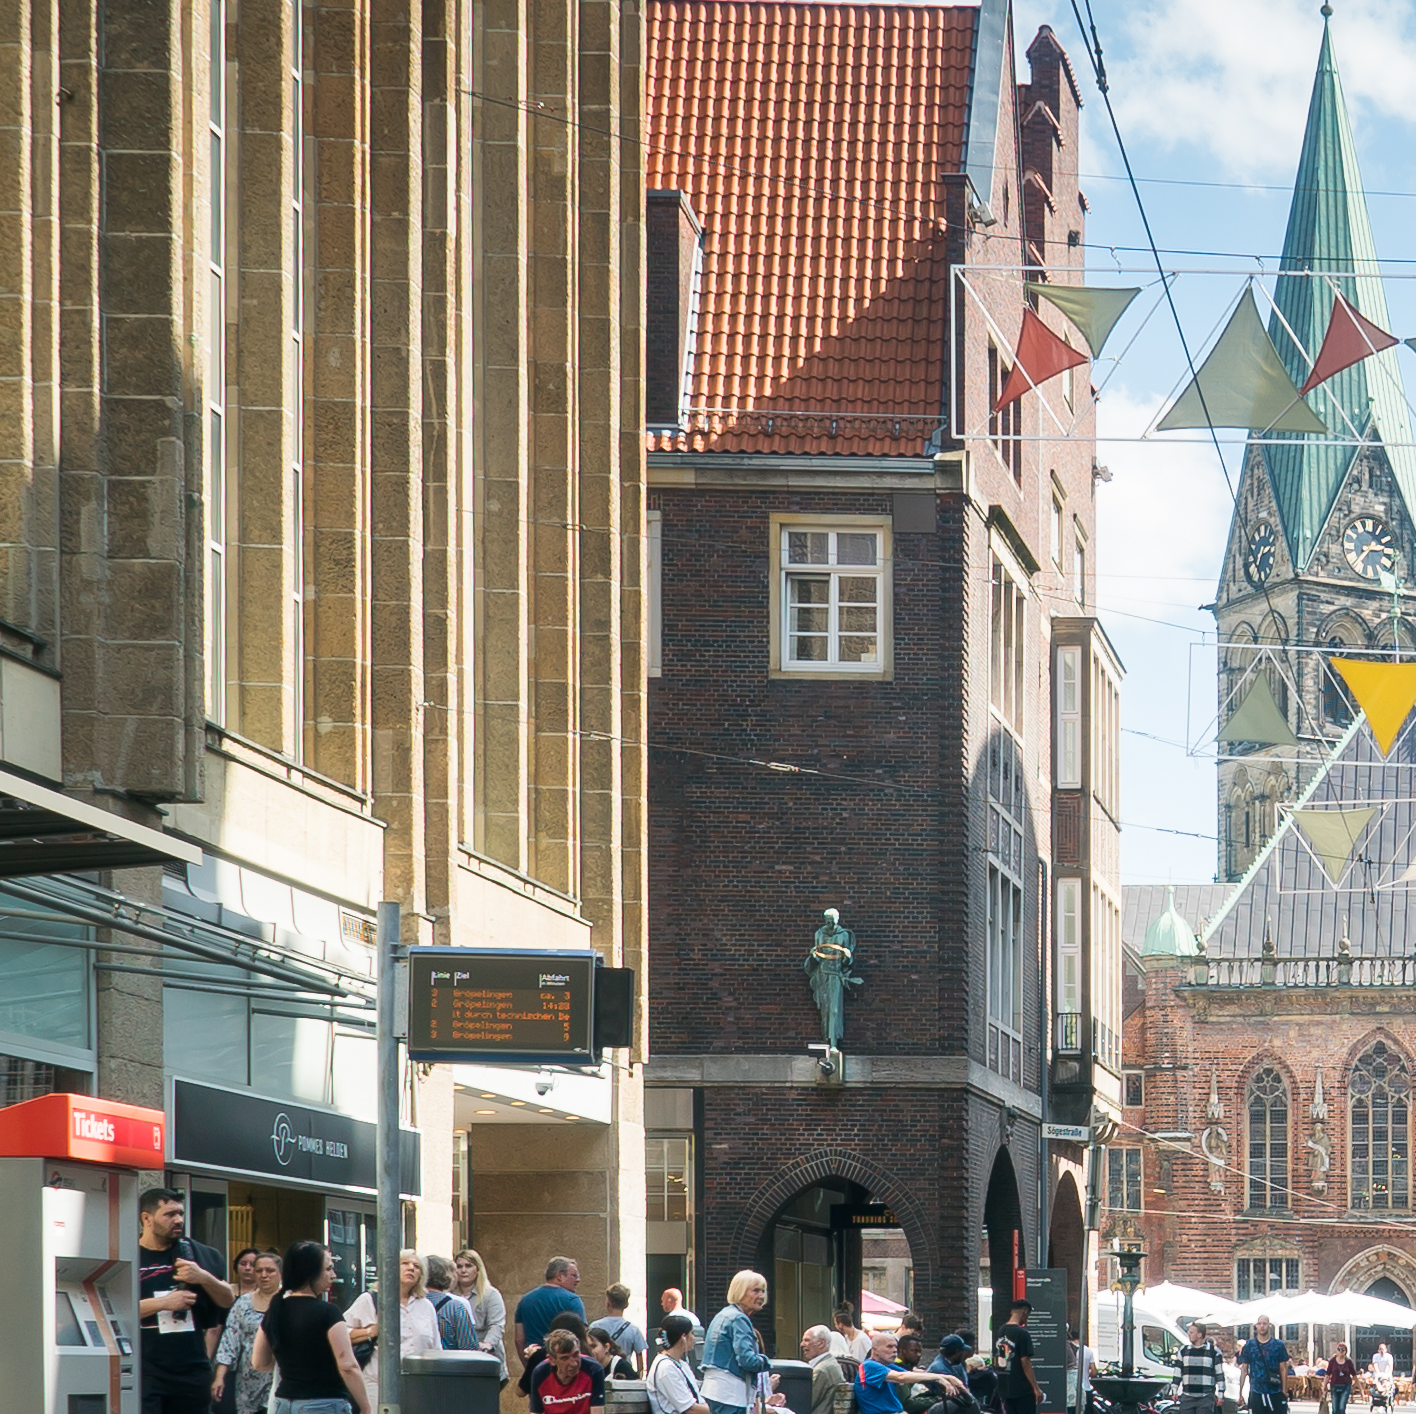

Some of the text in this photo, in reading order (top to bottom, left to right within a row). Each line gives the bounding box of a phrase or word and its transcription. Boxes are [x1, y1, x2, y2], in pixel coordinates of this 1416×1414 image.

[456, 971, 470, 979] Ziel
[542, 973, 570, 981] Abfahrt
[453, 989, 513, 1000] Gröpelingen
[453, 999, 513, 1010] Gröpelingen
[496, 1010, 556, 1021] technischen
[452, 1020, 513, 1031] Gröpelingen
[452, 1031, 513, 1042] Gröpelingen
[73, 1111, 115, 1142] Tickets
[542, 1391, 592, 1405] Champion
